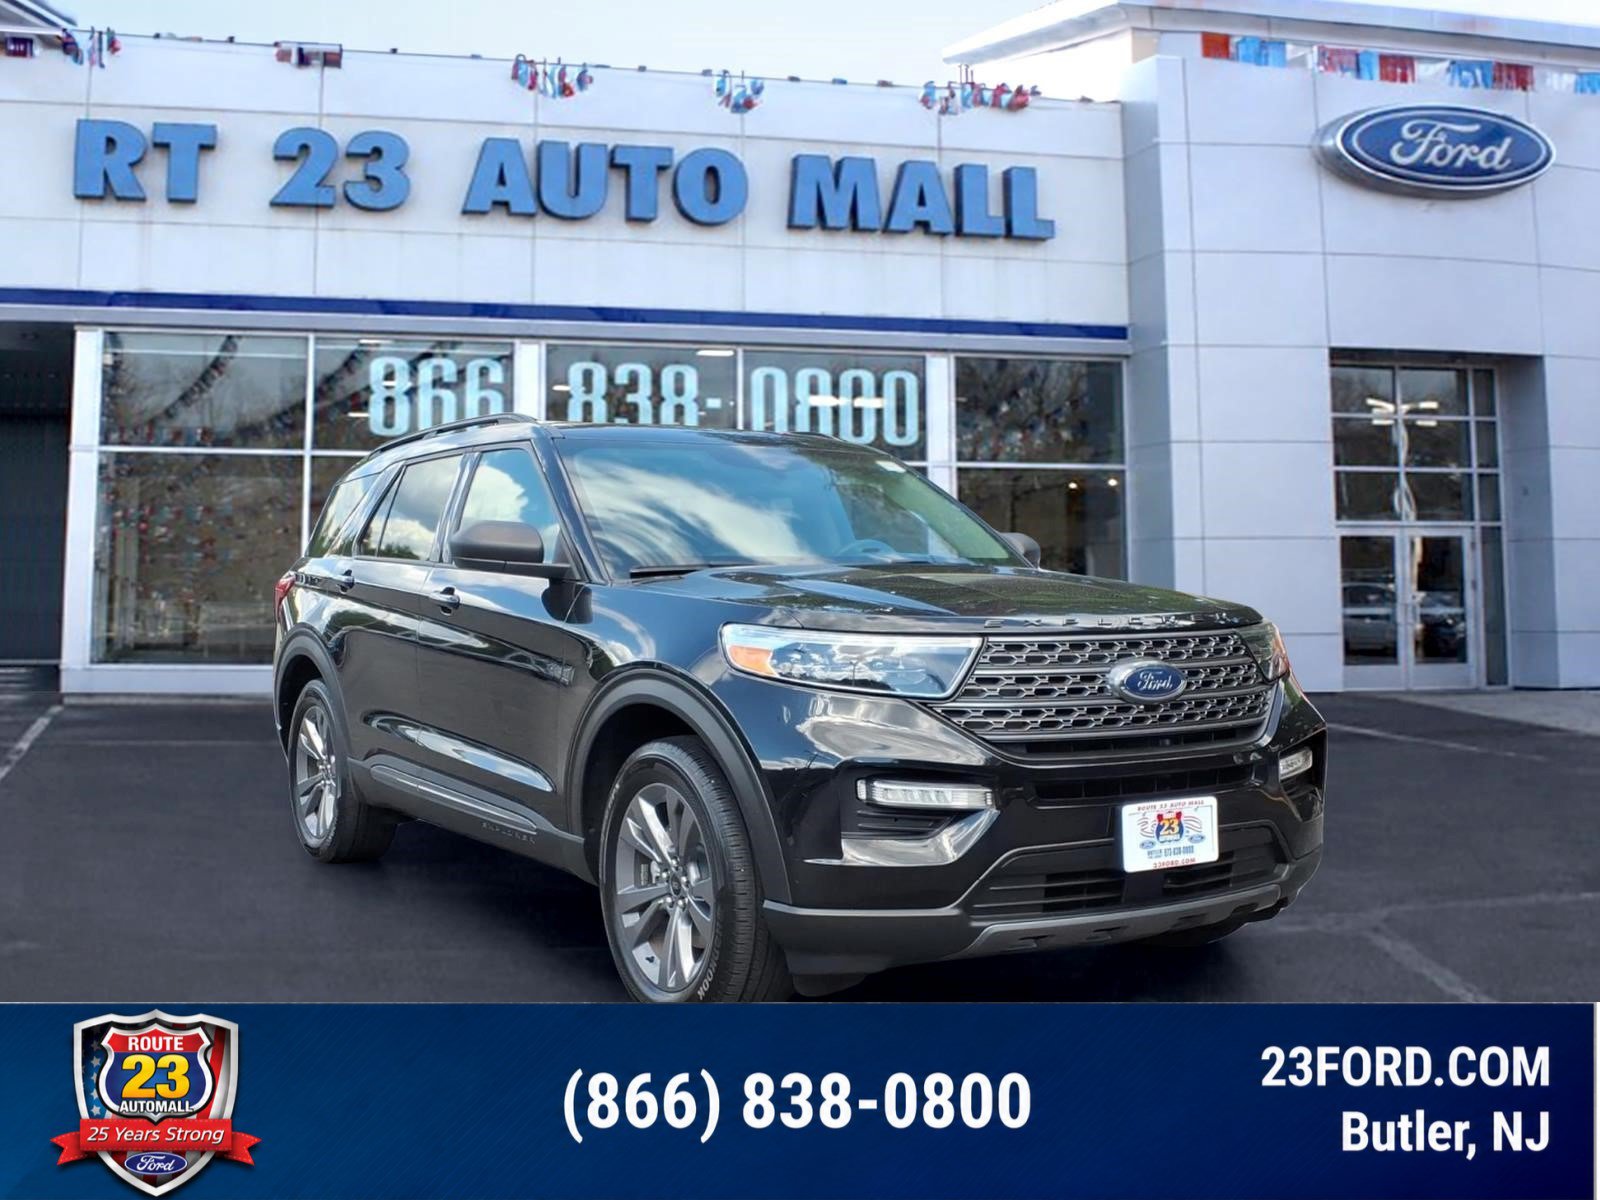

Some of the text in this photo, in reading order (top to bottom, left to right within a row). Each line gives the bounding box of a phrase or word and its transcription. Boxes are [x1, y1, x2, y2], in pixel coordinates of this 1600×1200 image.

[1389, 118, 1513, 171] Ford
[73, 118, 1056, 241] RT 23 AUTO MALL
[368, 356, 505, 437] 866
[1137, 670, 1174, 692] Ford
[1160, 817, 1180, 836] 23
